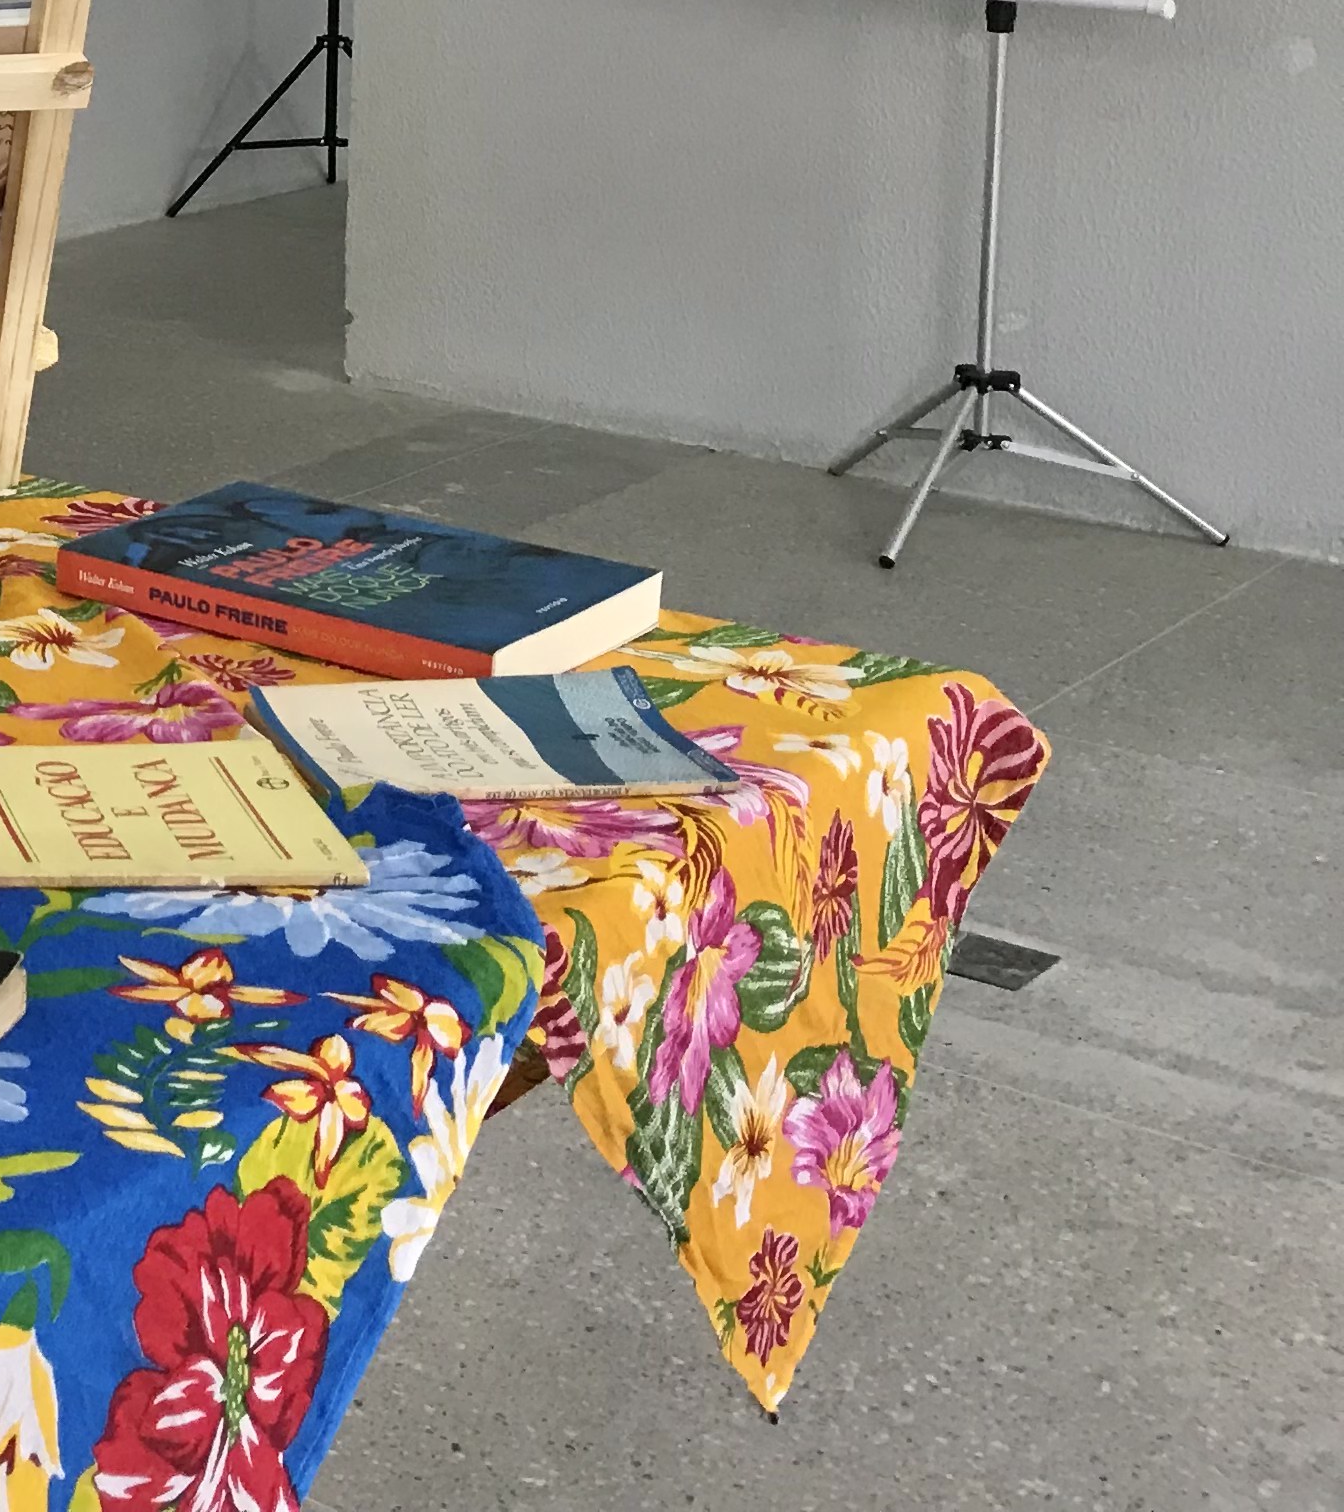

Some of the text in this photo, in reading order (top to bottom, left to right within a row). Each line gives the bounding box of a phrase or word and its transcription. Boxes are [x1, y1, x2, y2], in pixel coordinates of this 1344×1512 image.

[178, 552, 216, 570] Walter
[209, 537, 323, 580] PAULO
[245, 538, 375, 587] FREIRE
[78, 569, 106, 588] Walter
[148, 585, 209, 614] PAULO
[214, 603, 288, 635] FREIRE
[308, 563, 414, 603] DO QUE
[340, 574, 444, 610] NUNCA
[379, 692, 424, 719] LER
[406, 722, 441, 738] DE
[35, 761, 131, 861] EDUCAÇÃO
[110, 805, 150, 818] E
